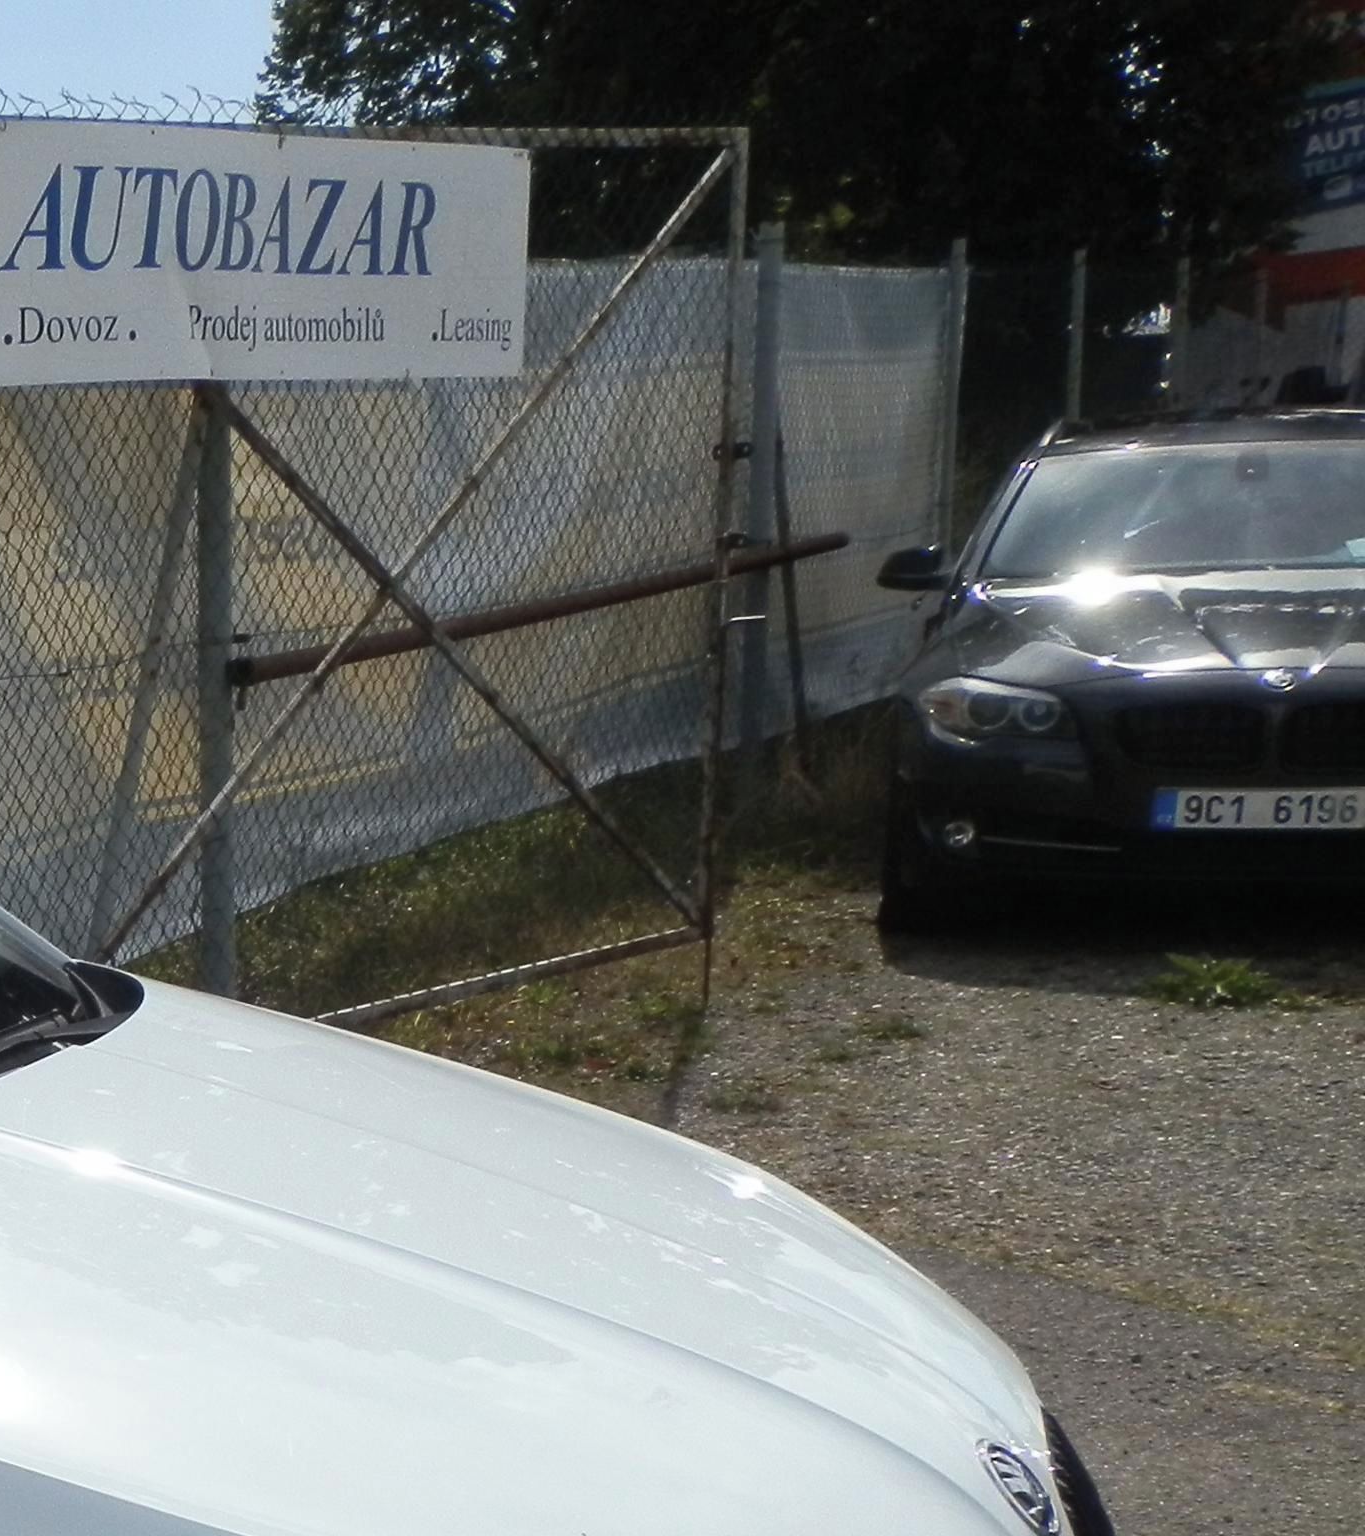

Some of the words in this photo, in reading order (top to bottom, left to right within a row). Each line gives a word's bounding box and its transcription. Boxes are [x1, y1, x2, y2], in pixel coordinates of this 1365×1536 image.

[0, 162, 437, 277] AUTOBAZAR
[188, 304, 258, 351] Prodej
[264, 306, 386, 343] automobilů
[1184, 795, 1246, 825] 9C1
[1273, 795, 1358, 825] 6196
